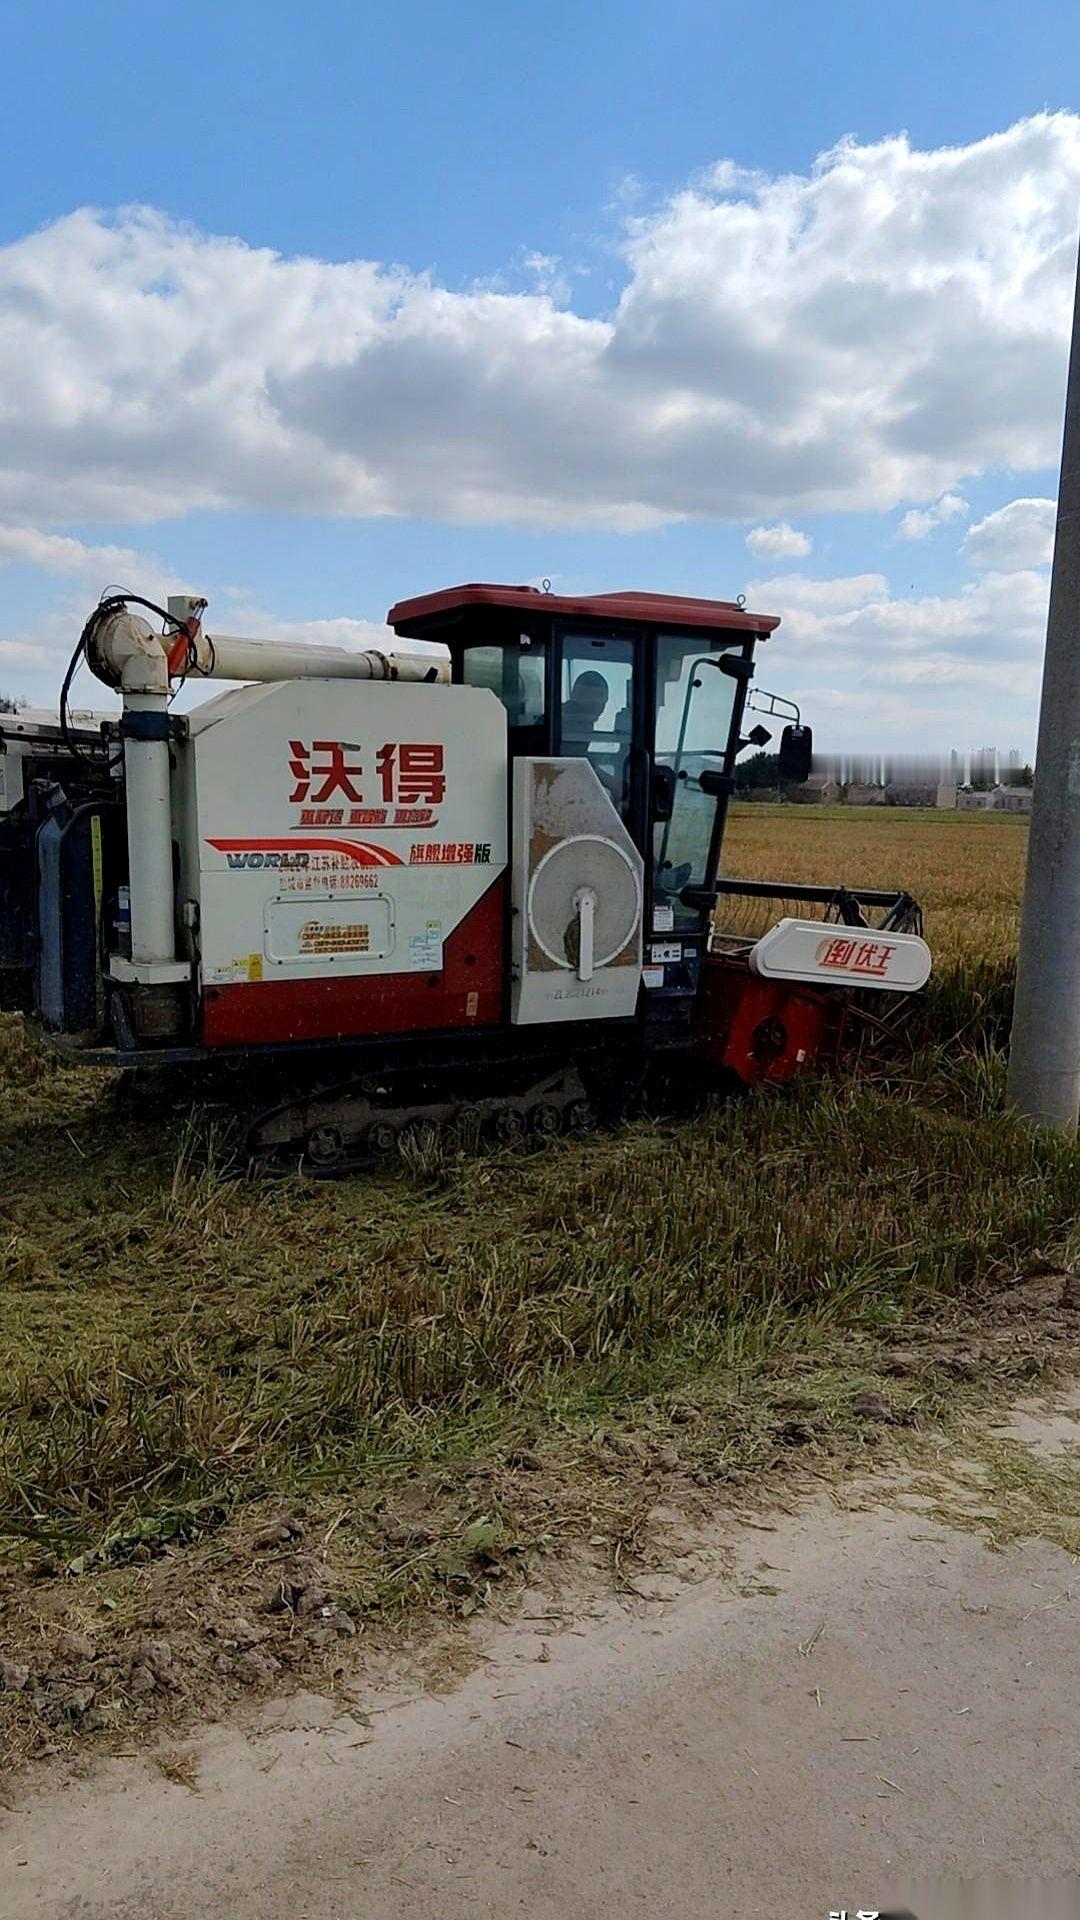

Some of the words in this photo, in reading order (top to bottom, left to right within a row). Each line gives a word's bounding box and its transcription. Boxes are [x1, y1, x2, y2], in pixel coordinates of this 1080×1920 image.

[288, 740, 446, 804] 沃得
[226, 853, 309, 868] WORLD
[409, 843, 491, 864] 旗舰增强版
[823, 939, 897, 970] 倒伏王
